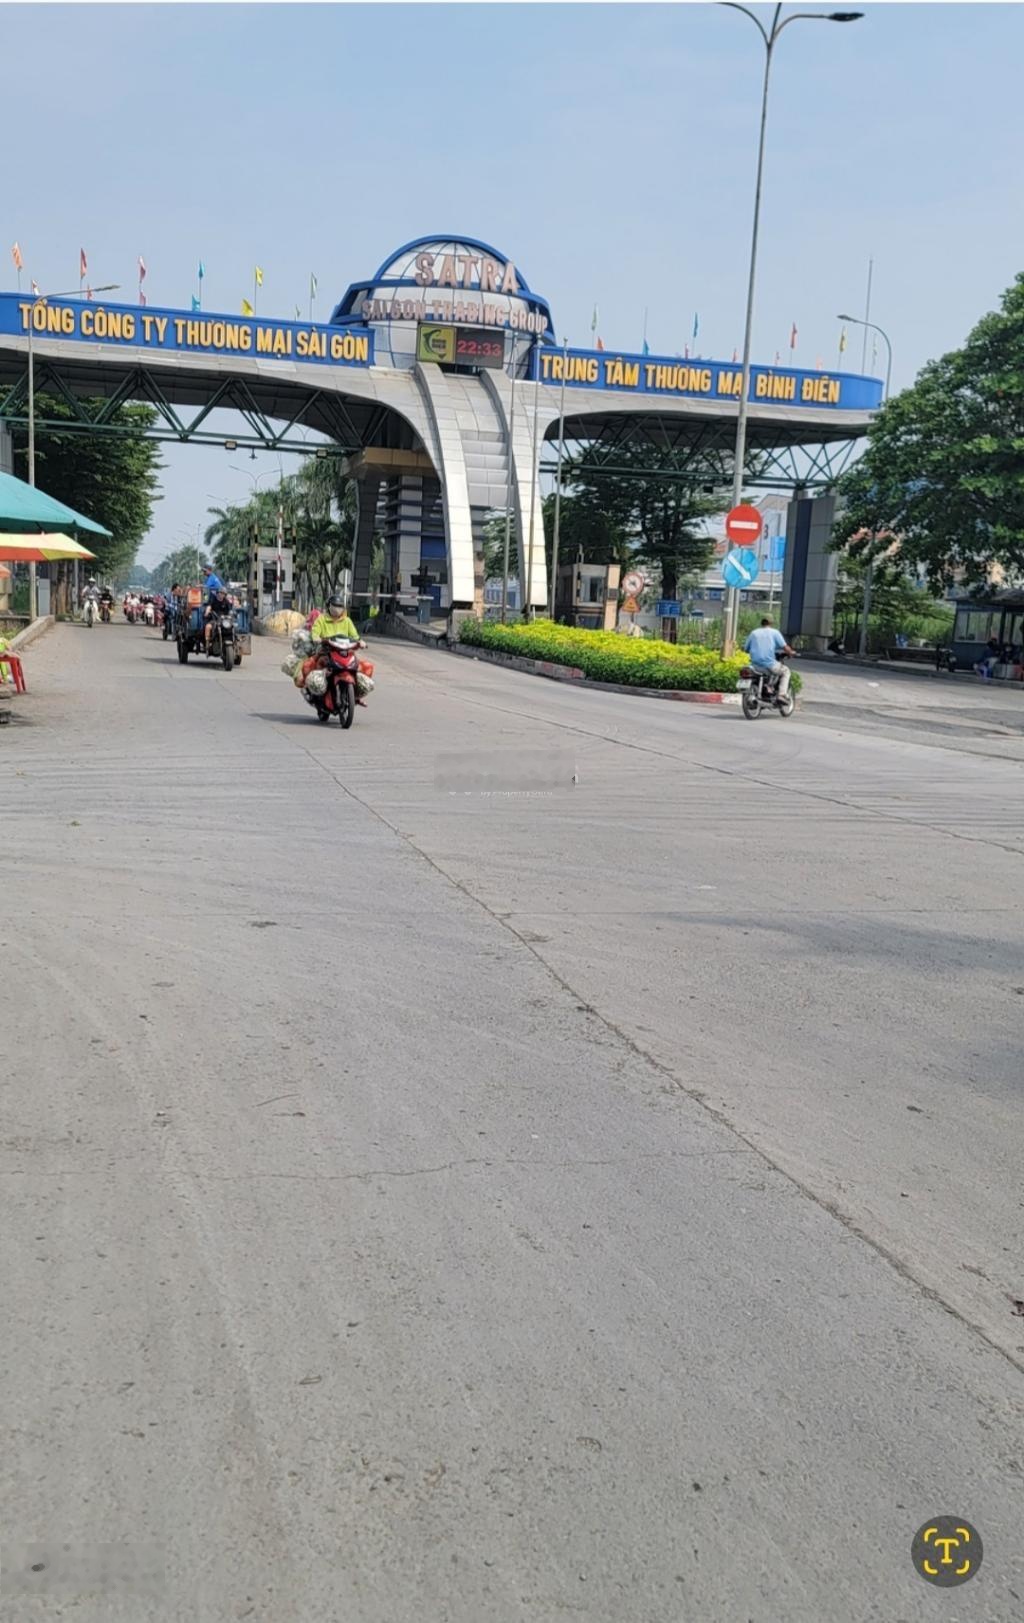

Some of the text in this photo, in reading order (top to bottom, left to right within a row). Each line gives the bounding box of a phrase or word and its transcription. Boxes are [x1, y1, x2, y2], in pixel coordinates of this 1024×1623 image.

[415, 252, 521, 294] SATRA
[19, 298, 368, 361] TỔNG CÔNG TY THƯƠNG MẠI SÀI GÒN
[431, 300, 505, 326] TRADING
[509, 309, 548, 334] GROUP
[457, 340, 502, 356] 22:33
[541, 355, 599, 382] TRUNG
[604, 356, 640, 386] TÂM
[645, 363, 712, 392] THƯƠNG
[756, 370, 796, 400] BÌNH
